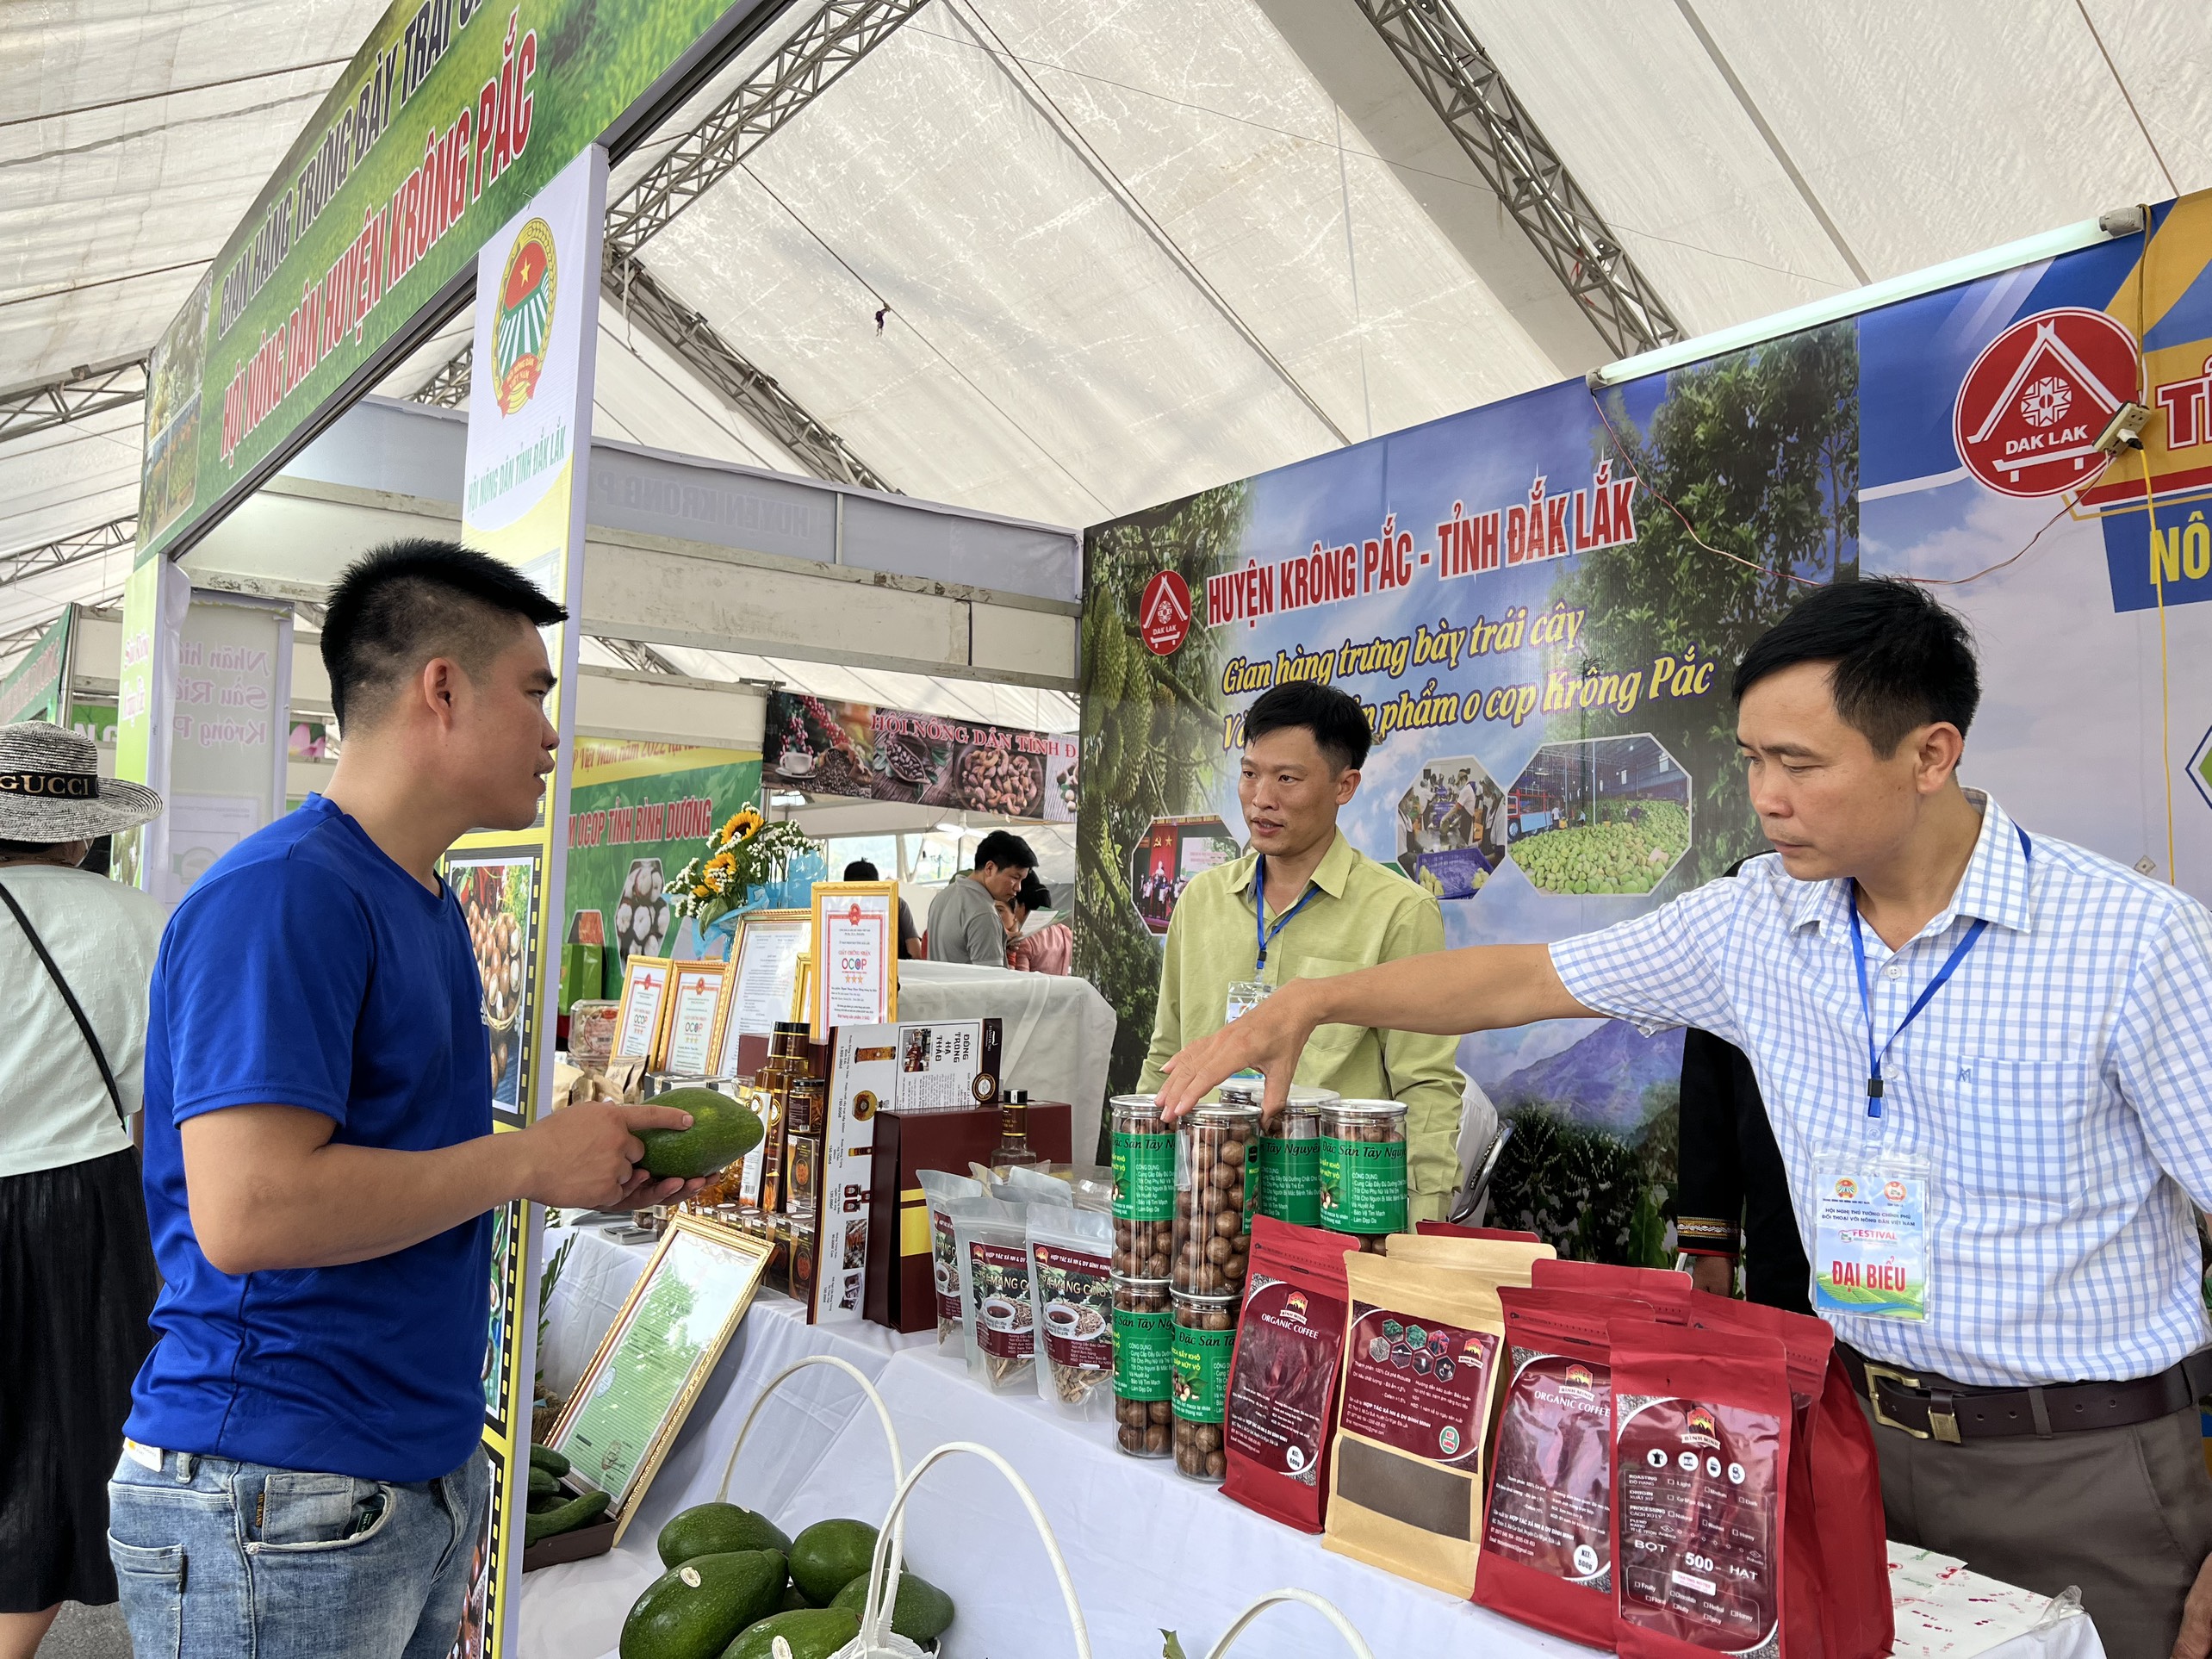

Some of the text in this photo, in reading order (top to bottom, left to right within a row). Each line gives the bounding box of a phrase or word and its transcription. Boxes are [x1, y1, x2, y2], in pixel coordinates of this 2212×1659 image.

[219, 243, 252, 340] GIAN
[251, 202, 293, 301] HÀNG
[295, 106, 353, 245] TRƯNG
[353, 38, 400, 171] BÀY
[221, 4, 537, 469] HỘI NÔNG DÂN HUYỆN KRÔNG PẮC
[2005, 424, 2089, 456] DAK LAK
[467, 416, 566, 517] HỘI NÔNG DÂN TỈNH ĐẮK LẮK
[1208, 559, 1273, 629] HUYỆN
[1279, 541, 1356, 612] KRÔNG
[1364, 512, 1413, 593] PẮC
[1438, 499, 1501, 581] TỈNH
[1506, 475, 1569, 566] ĐẮK
[1573, 460, 1636, 551] LẮK
[2149, 511, 2212, 586] NÔ
[1222, 603, 1586, 695] Gian hàng trưng bày trái cây
[1379, 679, 1458, 736] phẩm
[1463, 699, 1480, 723] o
[1484, 685, 1538, 729] cop
[1542, 666, 1641, 718] Krông
[1647, 642, 1715, 699] Pắc
[871, 713, 1077, 758] HỘI NÔNG DÂN TỈNH Đ
[581, 748, 594, 773] Việt
[0, 775, 88, 796] GUCCI
[577, 810, 606, 848] OCOP
[607, 796, 633, 845] TỈNH
[634, 797, 664, 843] BÌNH
[665, 794, 712, 841] DƯƠNG
[842, 958, 867, 971] OCOP
[935, 1035, 944, 1061] THẢO
[962, 1034, 971, 1059] ĐÔNG
[1124, 1139, 1163, 1151] Sản Tây
[1267, 1143, 1281, 1153] Tây
[1323, 1141, 1382, 1159] Đặc Sản Tây
[1853, 1229, 1898, 1240] FESTIVAL
[1832, 1255, 1905, 1292] ĐẠI BIỂU
[1120, 1315, 1155, 1331] Sản Tây
[1261, 1313, 1319, 1339] ORGANIC COFFEE
[1179, 1332, 1221, 1346] Đặc Sản
[1182, 1361, 1192, 1370] NỨT
[1364, 1401, 1373, 1410] HỢP
[1373, 1403, 1382, 1412] TÁC
[1534, 1390, 1610, 1417] ORGANIC COFFEE
[1704, 1437, 1718, 1447] MINH
[1519, 1517, 1527, 1525] TÁC
[1630, 1506, 1666, 1514] PROCESSING
[1578, 1561, 1593, 1570] 500g
[1685, 1551, 1713, 1572] 500
[1641, 1582, 1656, 1592] Fruity
[1709, 1603, 1724, 1612] Herbal
[1652, 1596, 1722, 1625] Floral Nutty Spicy
